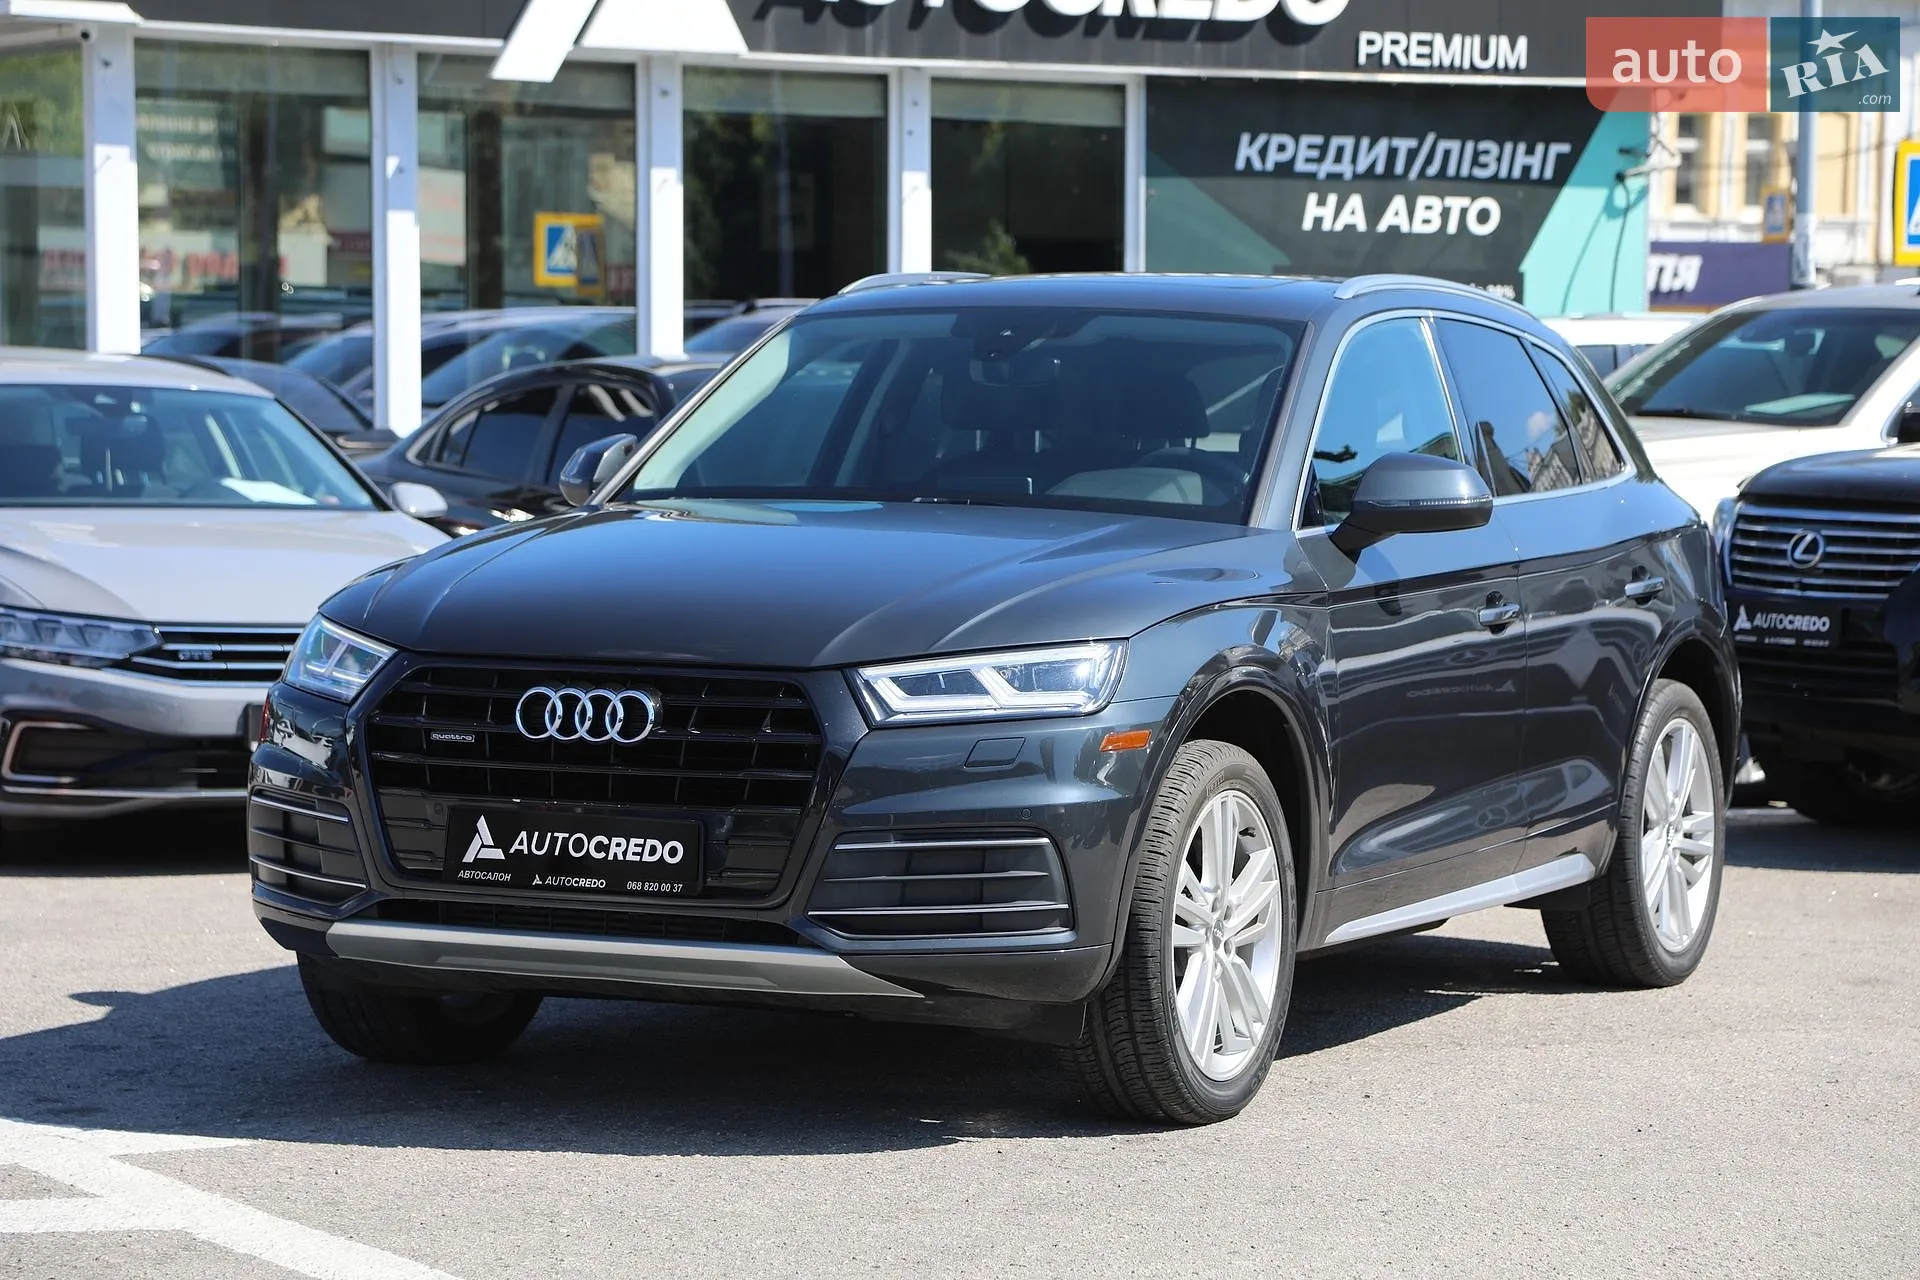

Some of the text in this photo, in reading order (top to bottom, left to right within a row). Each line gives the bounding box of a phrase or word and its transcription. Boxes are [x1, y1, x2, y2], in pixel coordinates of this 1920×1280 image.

[1357, 30, 1528, 71] PREMIUM
[1235, 131, 1571, 181] КРЕДИТ/ЛІЗІНГ
[1302, 191, 1501, 236] НА АВТО
[1753, 611, 1830, 632] AUTOCREDO
[432, 733, 473, 741] quattro
[509, 830, 685, 865] AUTOCREDO
[457, 869, 512, 882] АВТОСАЛОН
[544, 875, 606, 889] AUTOCREDO
[627, 881, 683, 893] 068 820 00 37
